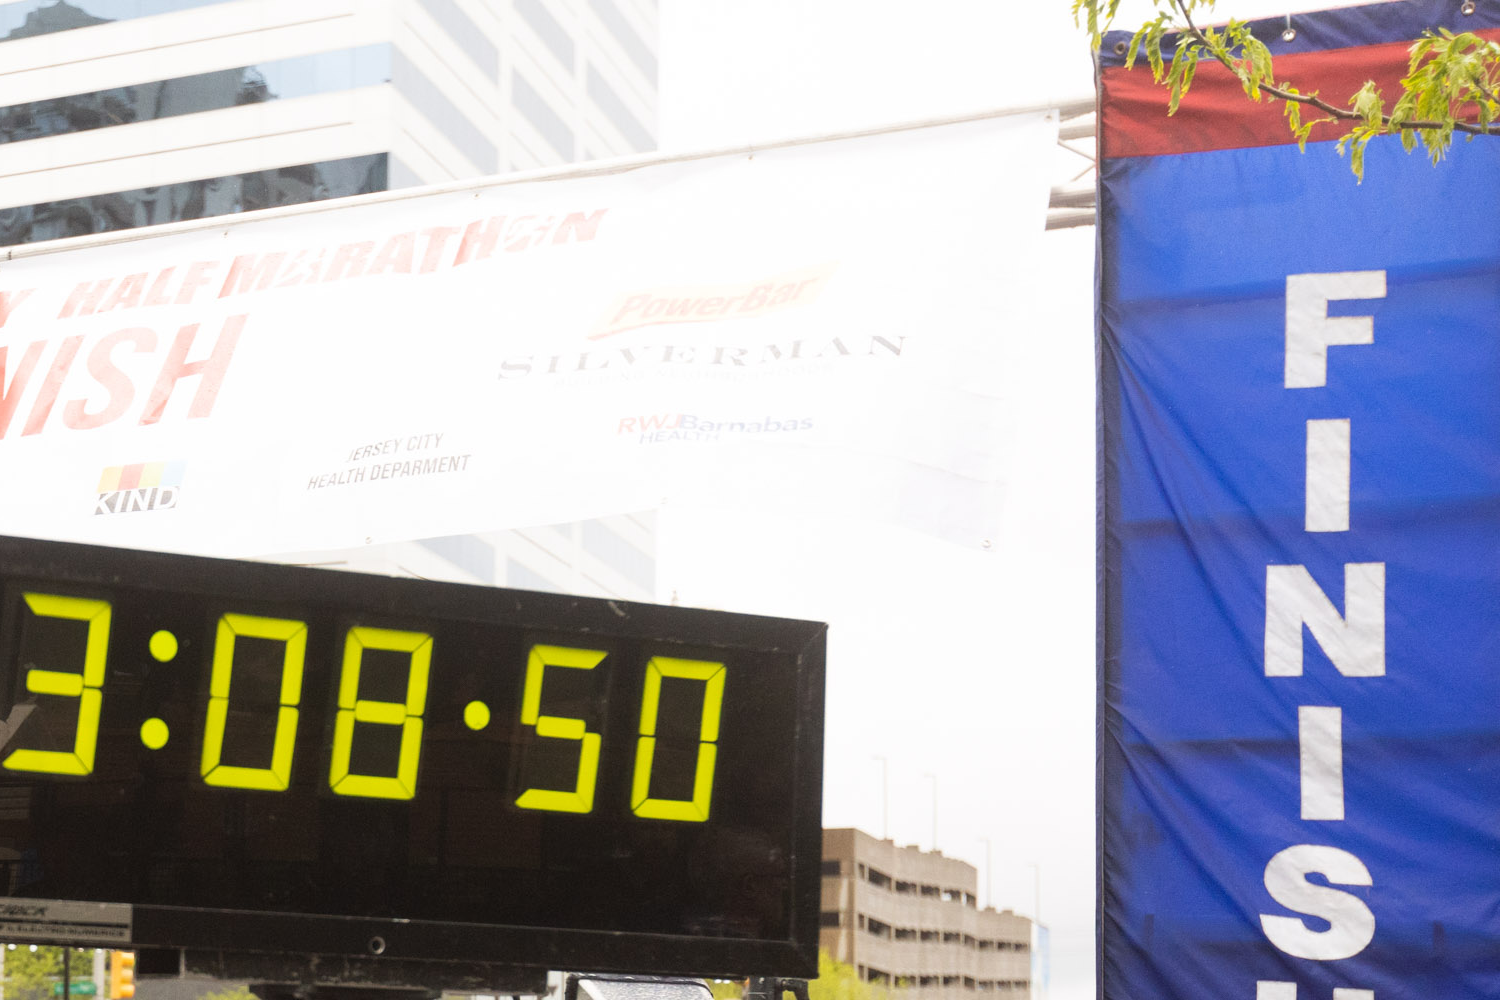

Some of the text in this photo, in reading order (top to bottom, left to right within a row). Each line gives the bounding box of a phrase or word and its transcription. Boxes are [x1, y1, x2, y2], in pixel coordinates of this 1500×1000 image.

[56, 260, 218, 320] HALF
[610, 276, 820, 325] PowerBar
[497, 334, 911, 381] SILVERMAN
[347, 433, 444, 462] JERSEY CITY
[639, 430, 721, 446] HEALTH
[306, 466, 366, 490] HEALTH
[95, 486, 179, 517] KIND
